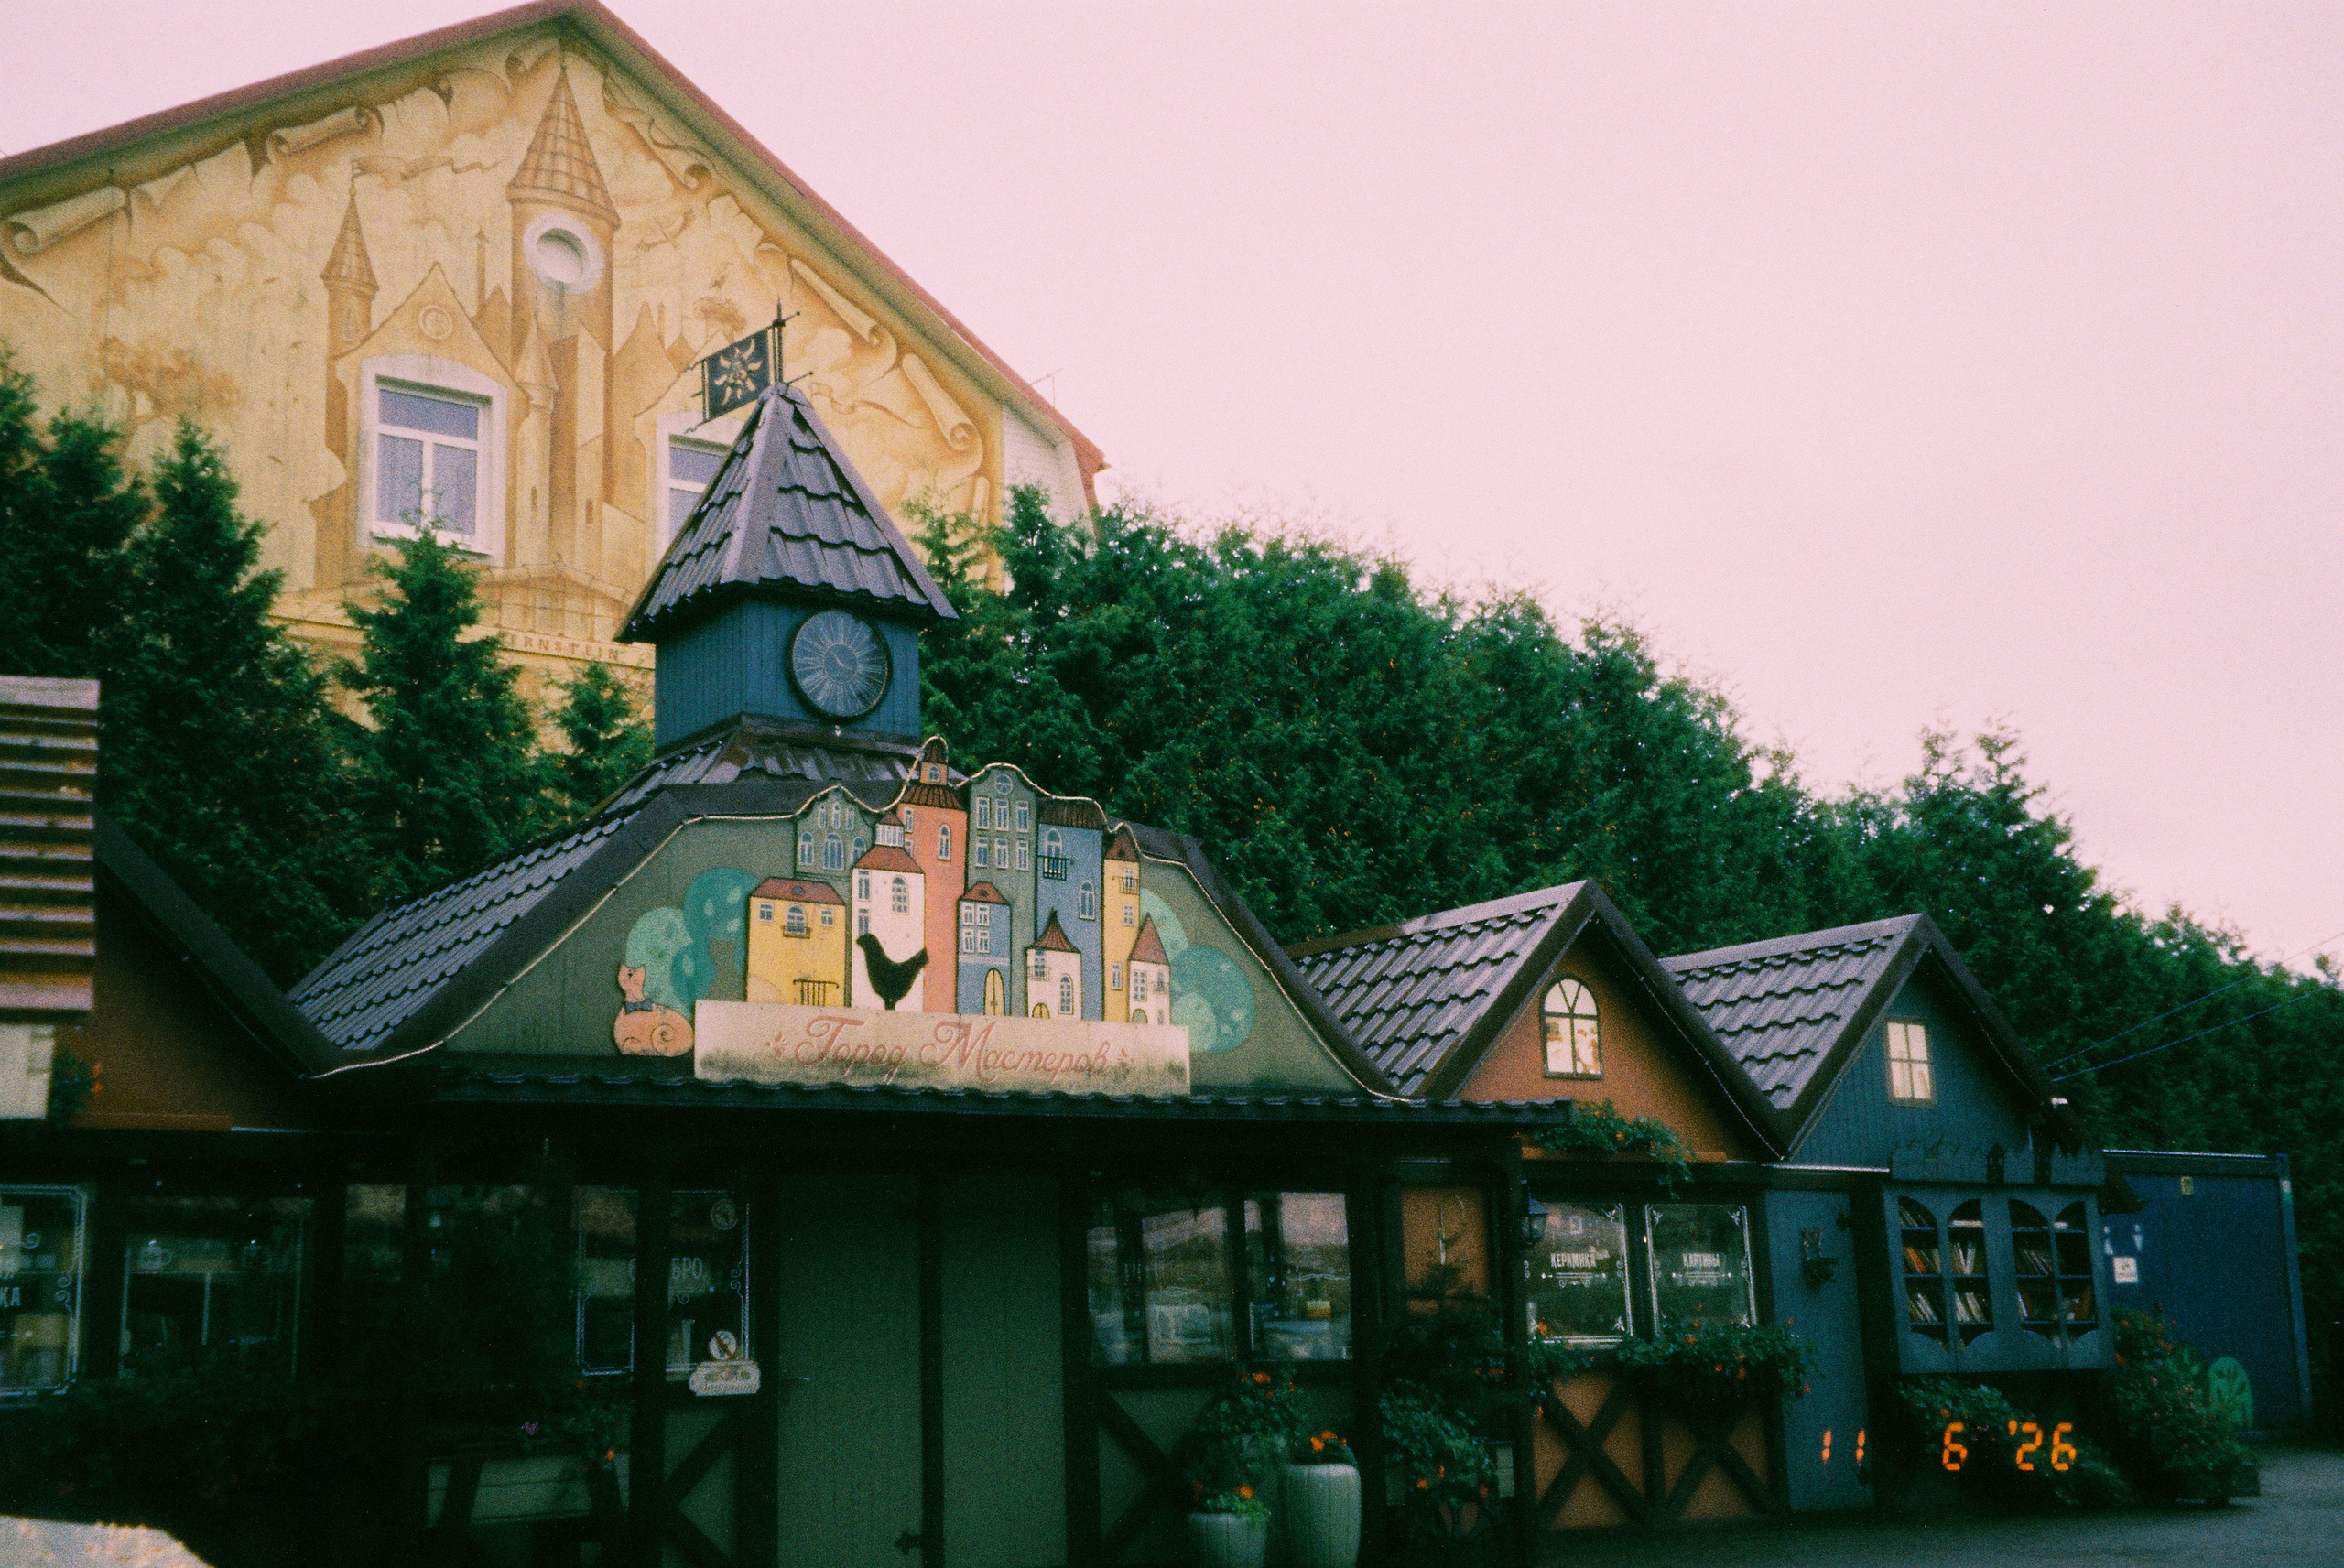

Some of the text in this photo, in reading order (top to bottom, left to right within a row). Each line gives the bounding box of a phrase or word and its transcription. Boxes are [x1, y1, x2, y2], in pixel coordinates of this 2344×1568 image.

[505, 633, 619, 661] ERNSTEIN
[795, 1015, 1111, 1084] Город Мастеров
